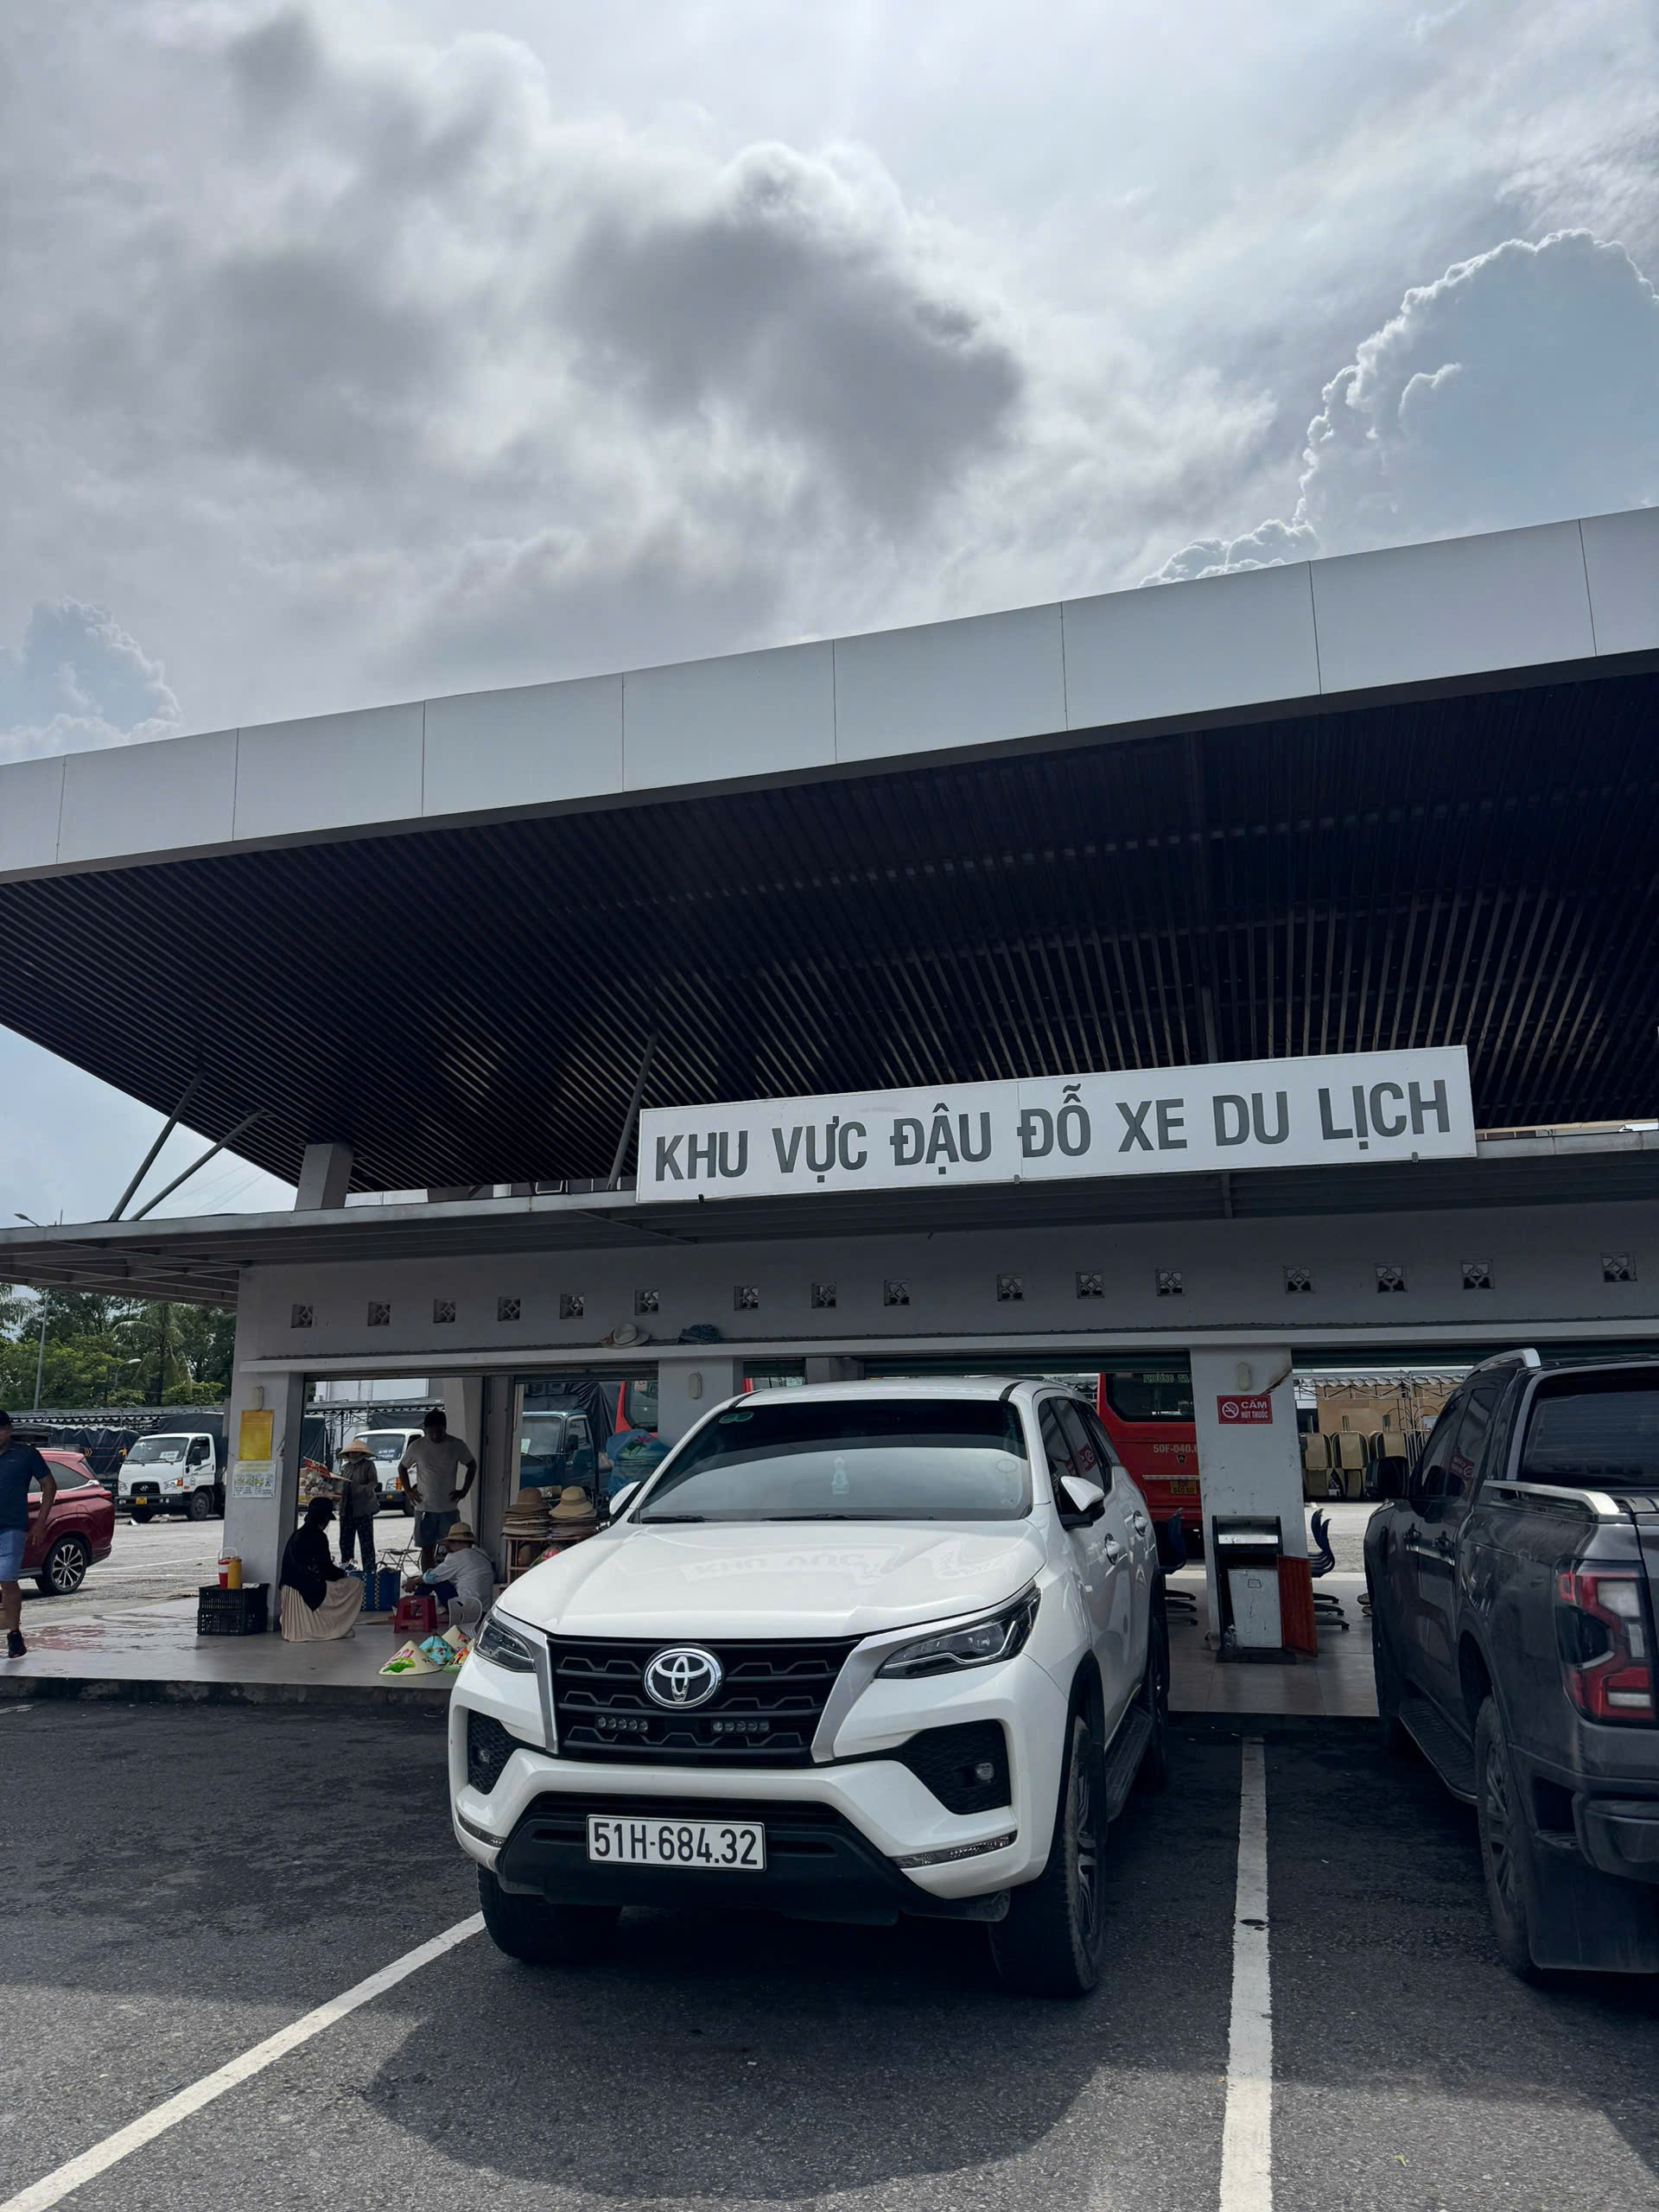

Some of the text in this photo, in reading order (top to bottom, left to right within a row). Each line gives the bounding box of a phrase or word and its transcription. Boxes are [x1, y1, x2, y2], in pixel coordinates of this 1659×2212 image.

[655, 1078, 1451, 1183] KHU VỰC ĐẬU ĐỖ XE DU LỊCH
[1241, 1398, 1268, 1409] CẤM
[594, 1821, 759, 1866] 51H-684.32
